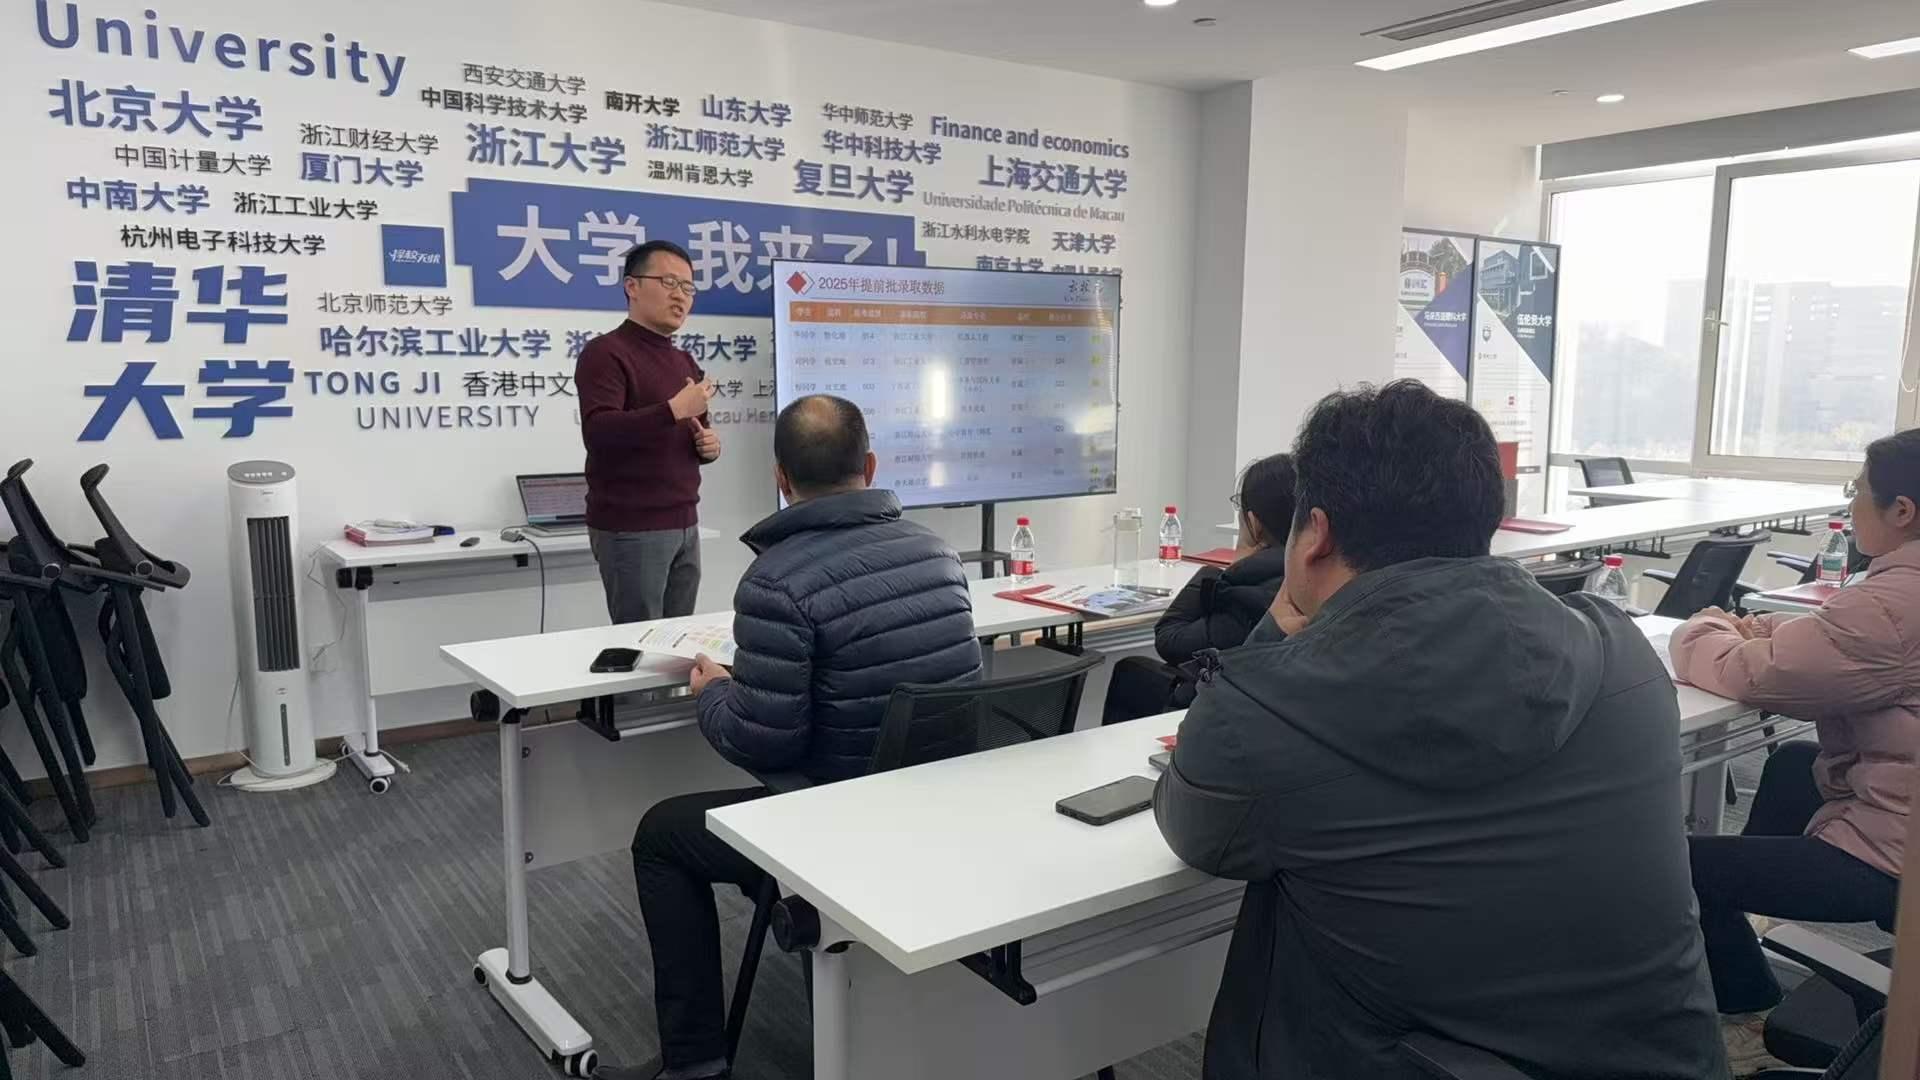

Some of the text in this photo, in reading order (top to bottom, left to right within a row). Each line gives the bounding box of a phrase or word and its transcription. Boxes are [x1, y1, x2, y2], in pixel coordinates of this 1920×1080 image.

[36, 0, 406, 97] University
[463, 62, 586, 96] 西安交通大学
[49, 78, 263, 141] 北京大学
[421, 86, 588, 124] 中国科学技术大学
[605, 90, 680, 118] 南开大学
[702, 94, 792, 128] 山东大学
[823, 103, 913, 131] 华中师范大学
[300, 123, 439, 154] 浙江财经大学
[466, 124, 626, 174] 浙江大学
[646, 123, 786, 161] 浙江师范大学
[823, 130, 942, 165] 华中科技大学
[931, 116, 1130, 159] Finance and economics
[115, 144, 271, 177] 中国计量大学
[300, 153, 424, 188] 厦门大学
[648, 159, 753, 188] 温州肯恩大学
[793, 159, 914, 202] 复旦大学
[978, 155, 1128, 200] 上海交通大学
[66, 178, 210, 215] 中南大学
[233, 192, 378, 221] 浙江工业大学
[923, 192, 1125, 222] Universidade Politécnica de Macau
[120, 224, 326, 256] 杭州电子科技大学
[922, 221, 1030, 244] 浙江水利水电学院
[1052, 231, 1116, 254] 天津大学
[66, 260, 289, 344] 清华
[818, 276, 945, 296] 2025年提前批录取数据
[318, 292, 453, 317] 北京师范大学
[319, 325, 552, 360] 哈尔滨工业大学
[304, 370, 442, 396] TONG JI
[462, 369, 579, 398] 香港中文
[76, 359, 295, 442] 大学
[356, 404, 540, 431] UNIVERSITY
[706, 410, 742, 425] acau
